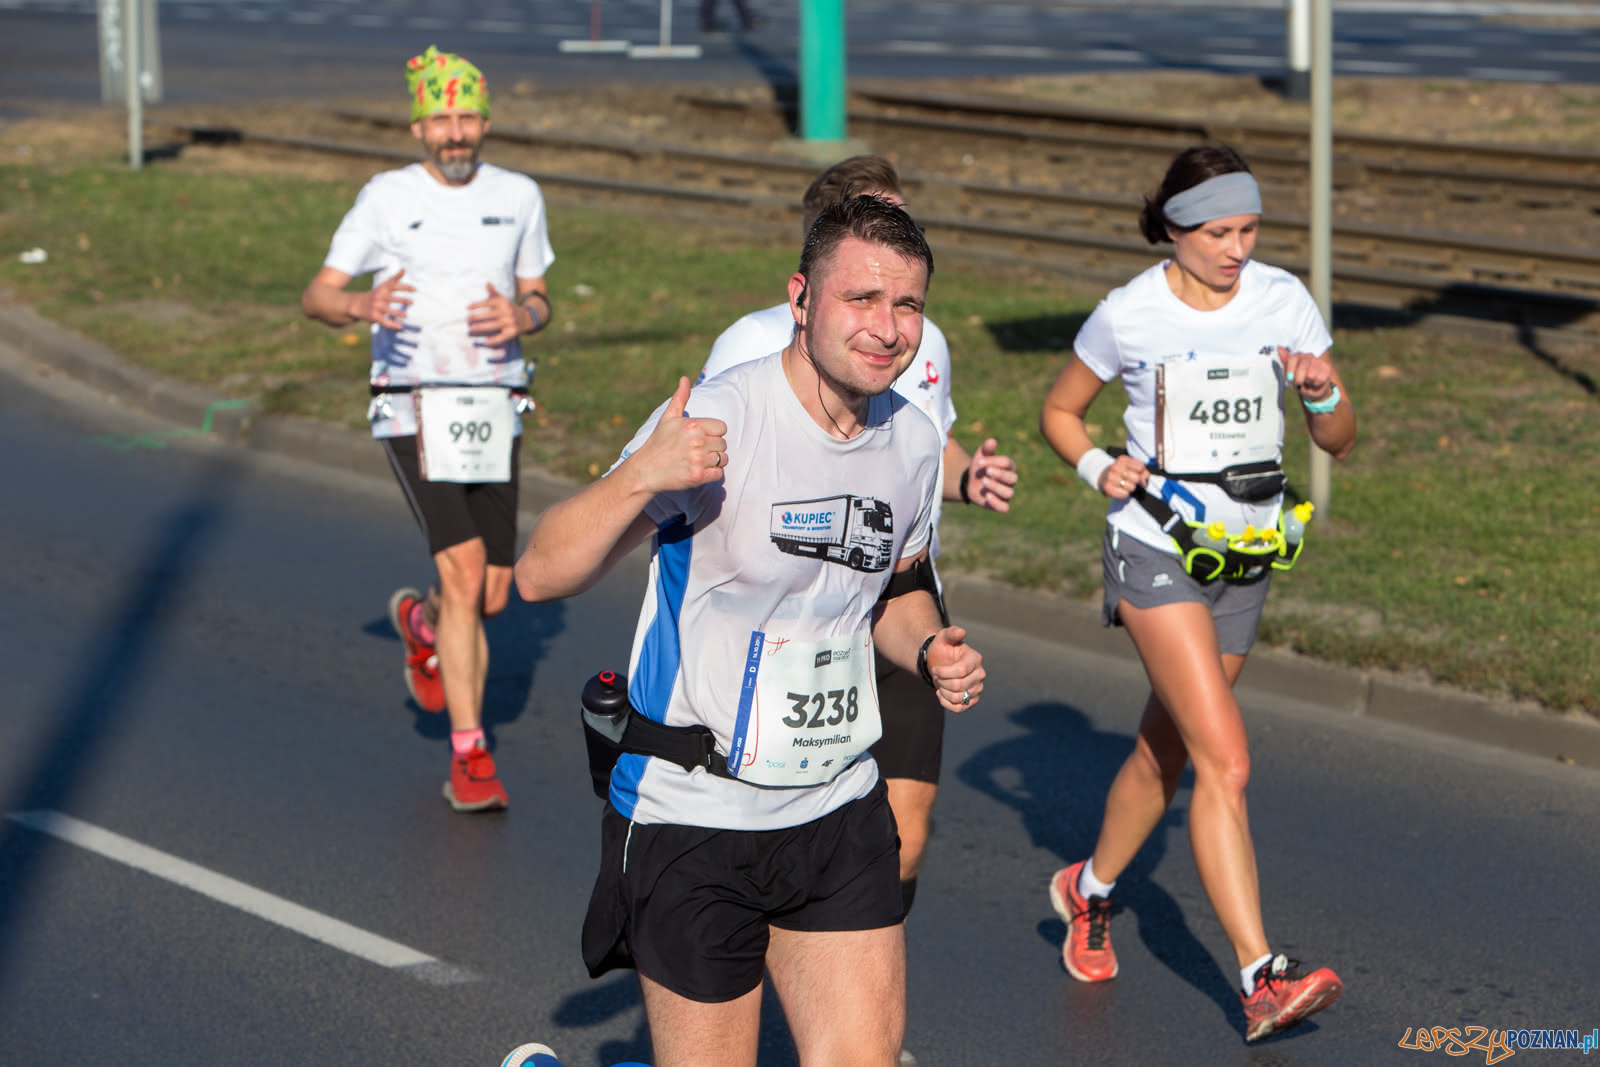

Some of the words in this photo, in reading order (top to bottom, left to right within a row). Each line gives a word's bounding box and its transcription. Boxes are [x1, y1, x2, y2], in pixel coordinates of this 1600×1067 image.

[1189, 396, 1263, 424] 4881
[449, 421, 492, 443] 990
[794, 512, 832, 524] KUPIEC
[782, 686, 858, 729] 3238
[792, 734, 852, 748] Maksymilian
